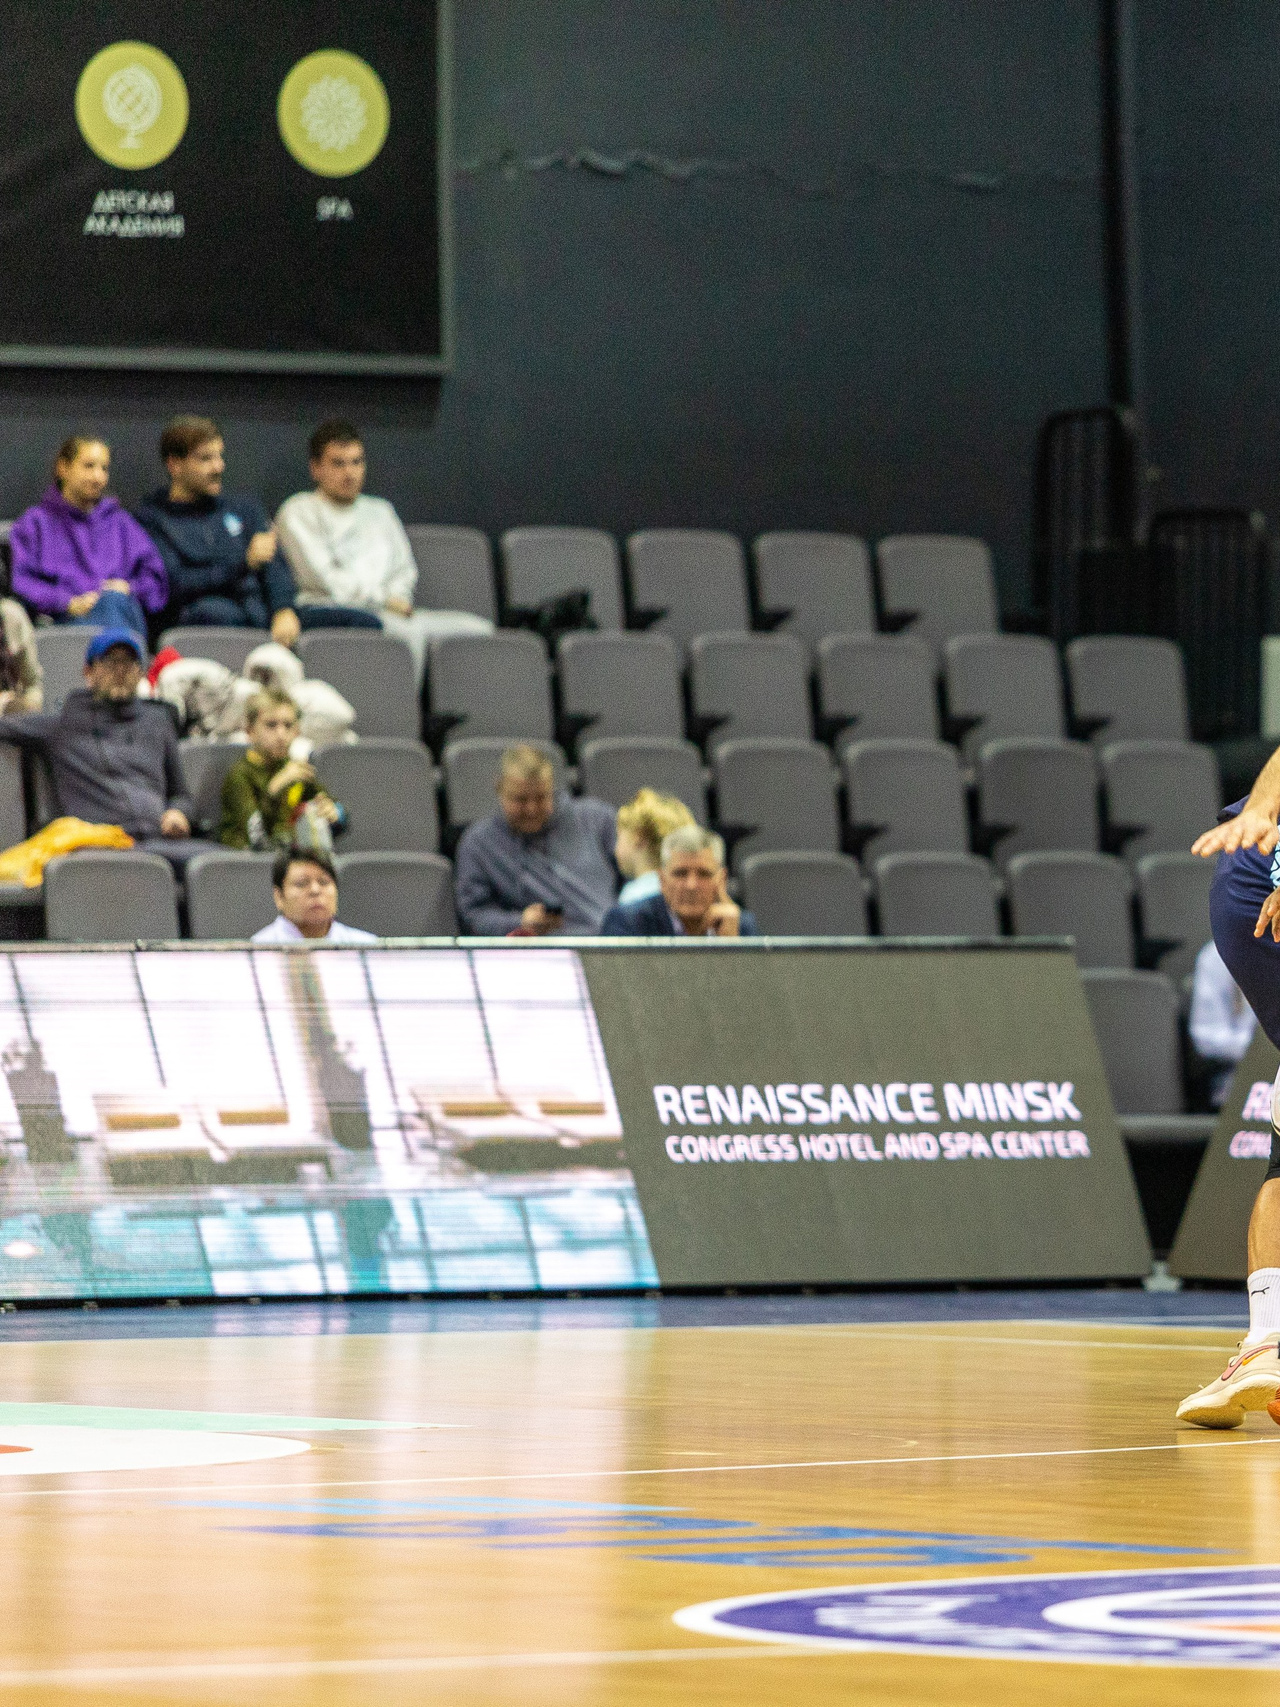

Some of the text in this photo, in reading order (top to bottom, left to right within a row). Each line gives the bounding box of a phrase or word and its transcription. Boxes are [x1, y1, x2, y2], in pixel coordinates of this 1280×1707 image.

[653, 1081, 1083, 1125] RENAISSANCE MINSK
[665, 1130, 1092, 1163] CONGRESS HOTEL AND SPA CENTER
